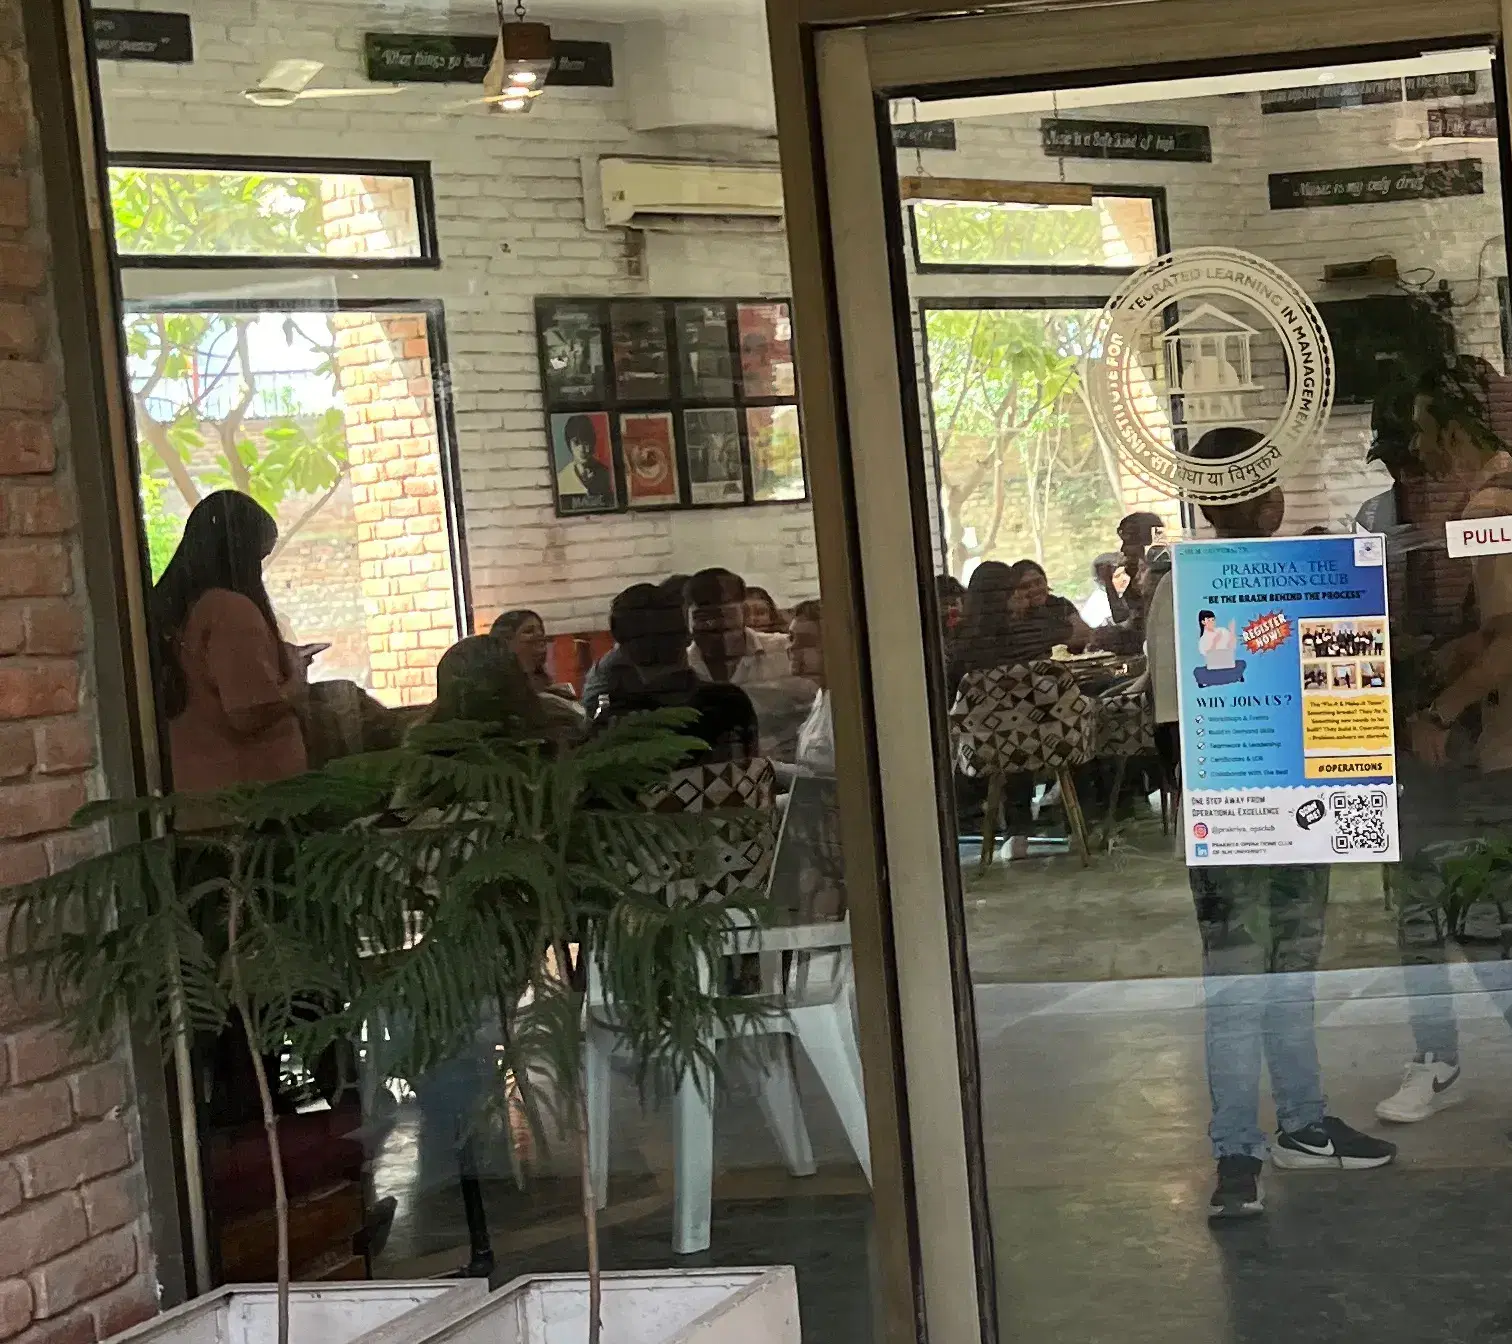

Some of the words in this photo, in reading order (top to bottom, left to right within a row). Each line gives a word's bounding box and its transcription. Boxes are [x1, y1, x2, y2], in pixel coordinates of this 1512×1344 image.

[1346, 180, 1364, 197] my
[1366, 176, 1392, 195] only
[1206, 267, 1283, 308] LEARNING
[1280, 305, 1298, 326] IN
[1286, 326, 1316, 443] MANAGEMENT
[1463, 527, 1511, 545] PULL
[1222, 560, 1298, 576] PRAKRIYA
[1307, 559, 1339, 572] THE
[1212, 573, 1307, 590] OPERATIONS
[1309, 572, 1349, 585] CLUB
[1221, 594, 1238, 604] THE
[1239, 593, 1268, 603] BRAIN
[1269, 592, 1302, 602] BEHIND
[1304, 591, 1321, 601] THE
[1242, 613, 1287, 643] REGISTER
[1255, 627, 1283, 648] NOW!
[1196, 696, 1225, 708] WHY
[1230, 696, 1261, 708] JOIN
[1265, 695, 1282, 706] US
[1318, 762, 1383, 772] #OPERATIONS
